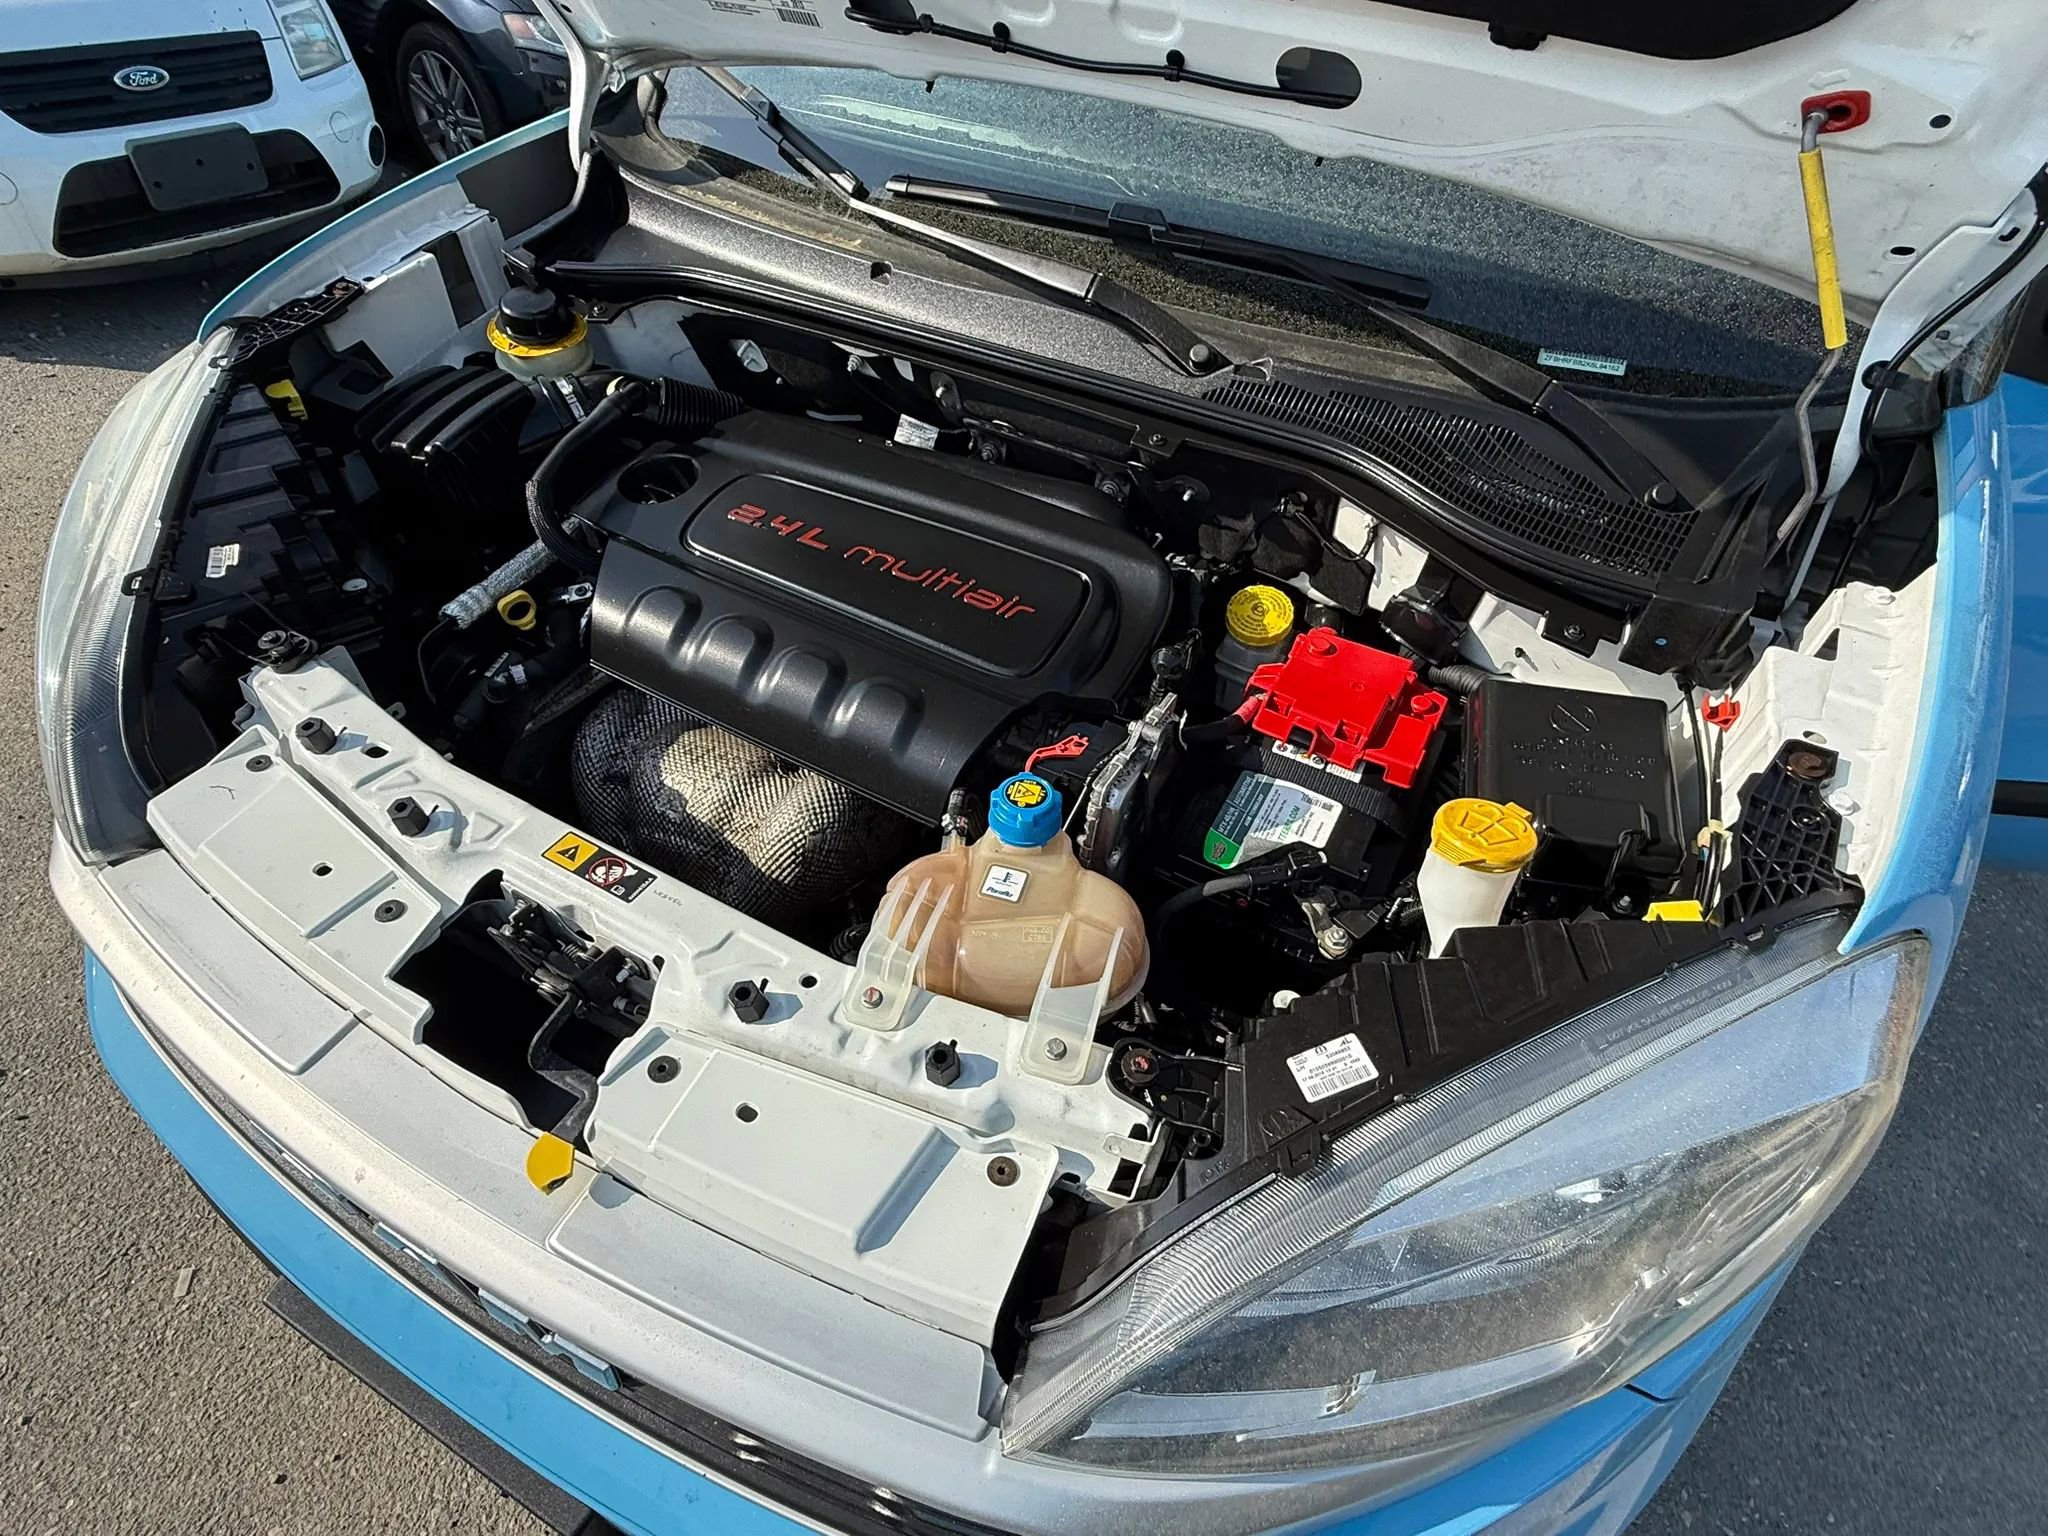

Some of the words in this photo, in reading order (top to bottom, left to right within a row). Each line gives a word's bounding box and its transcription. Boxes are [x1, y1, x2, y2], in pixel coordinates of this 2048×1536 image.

[129, 71, 158, 87] Ford
[727, 503, 830, 551] 2.4L
[842, 545, 1036, 619] multiair
